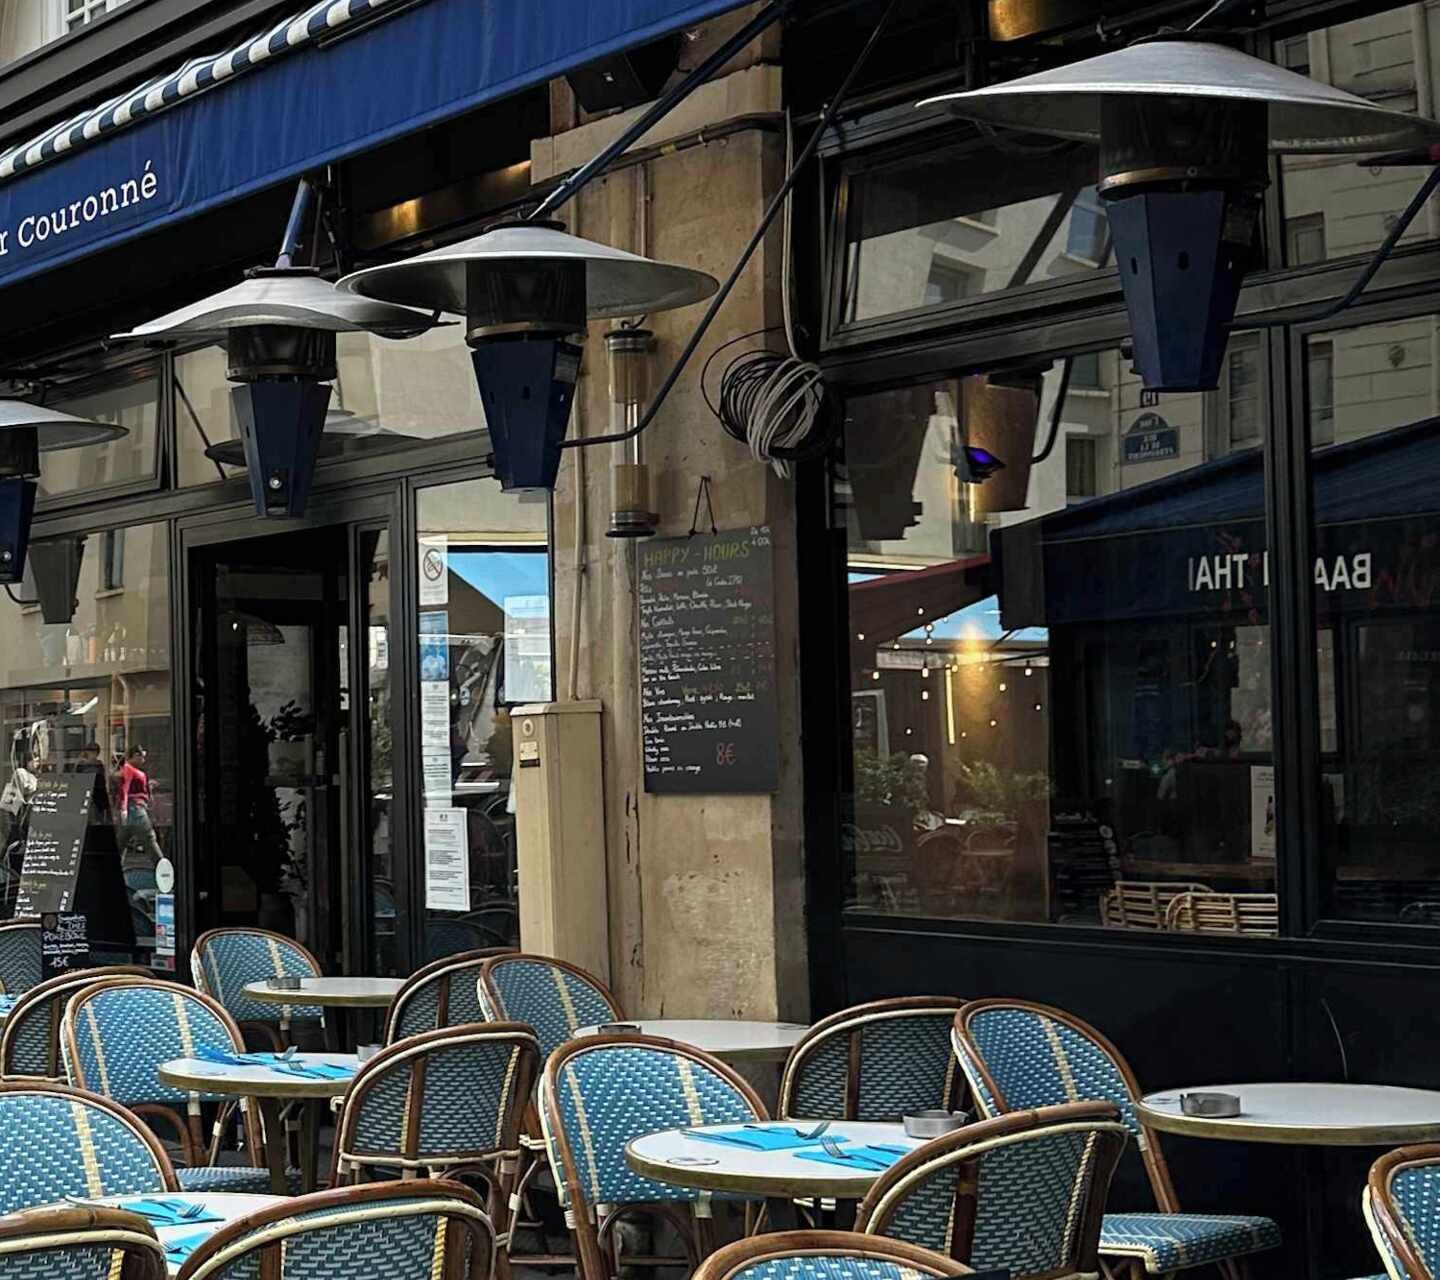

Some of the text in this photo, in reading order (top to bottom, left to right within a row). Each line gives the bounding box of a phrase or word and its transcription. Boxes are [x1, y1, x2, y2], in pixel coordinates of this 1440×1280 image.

[17, 160, 158, 248] Couronné
[643, 541, 751, 567] HAPPY HOURS
[716, 742, 737, 765] 8€
